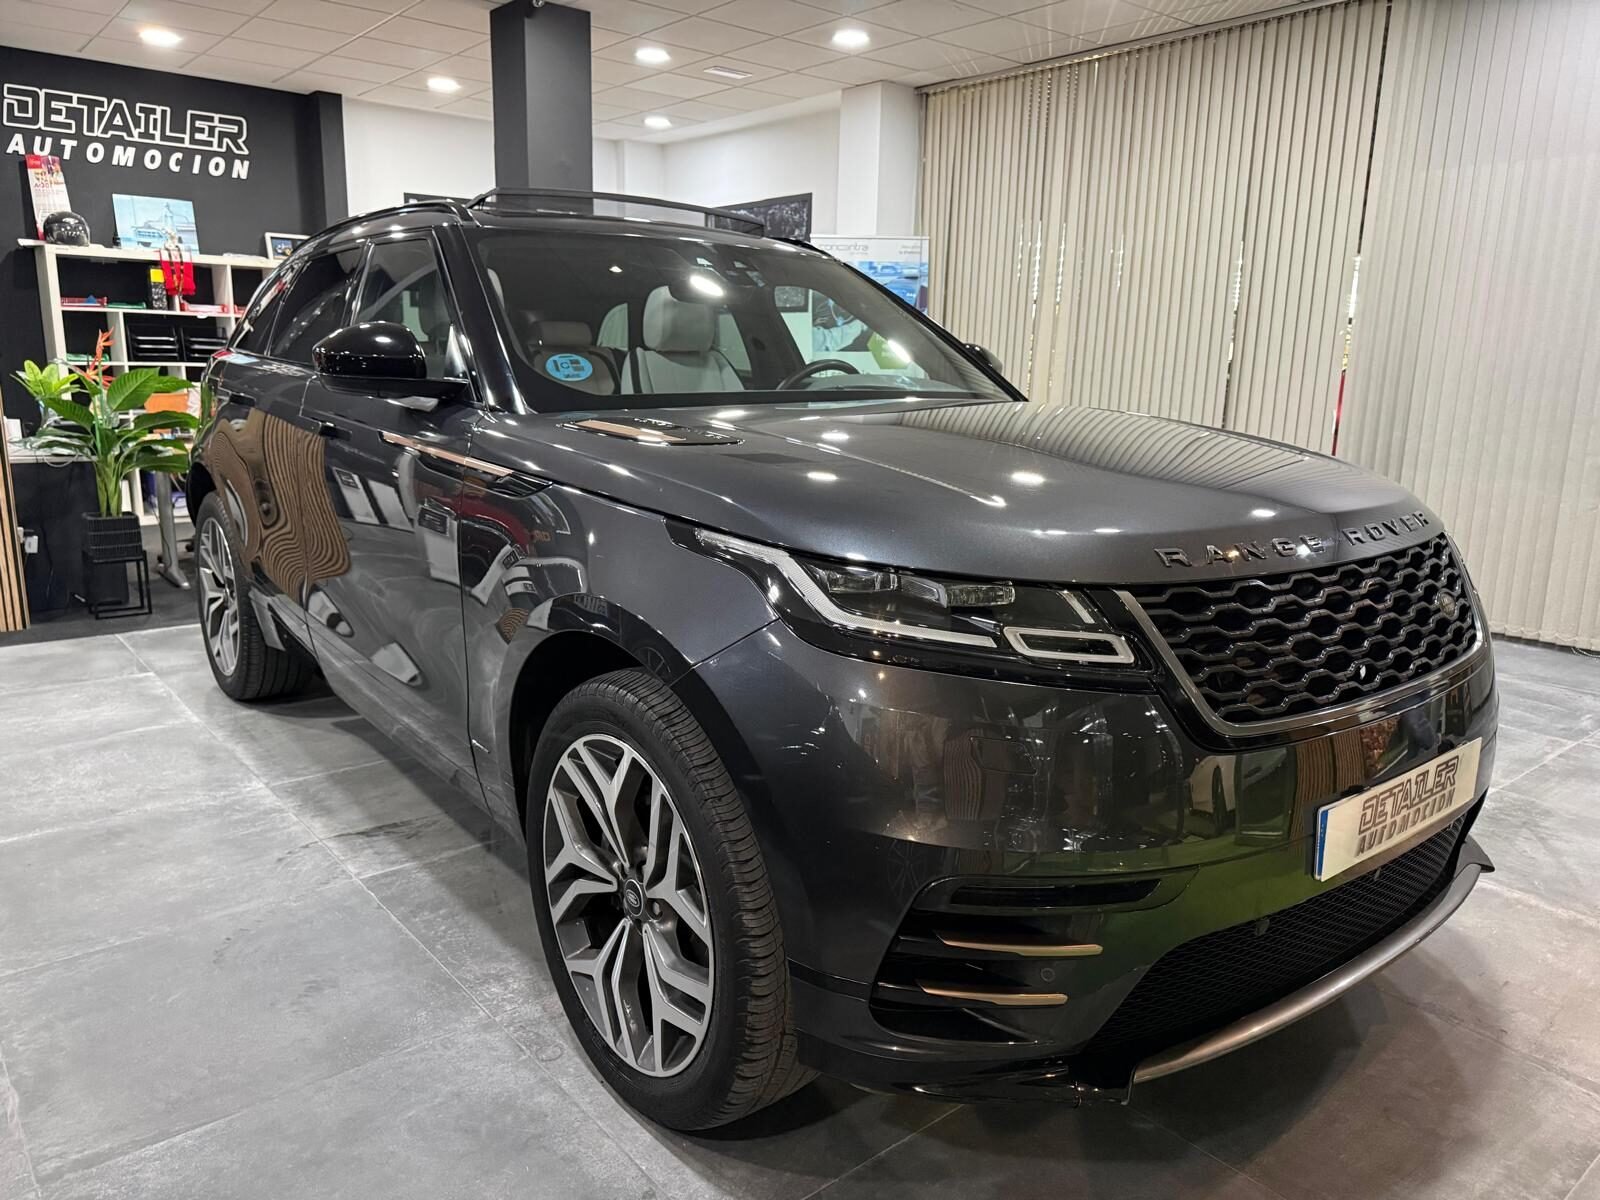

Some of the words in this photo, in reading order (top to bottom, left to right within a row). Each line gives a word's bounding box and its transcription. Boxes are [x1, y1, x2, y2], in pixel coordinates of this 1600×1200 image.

[3, 84, 249, 155] DETAILER
[6, 134, 250, 180] AUTOMOCION
[1153, 534, 1326, 568] RANGE
[1341, 511, 1431, 546] ROVER
[1357, 755, 1460, 835] DETAILER
